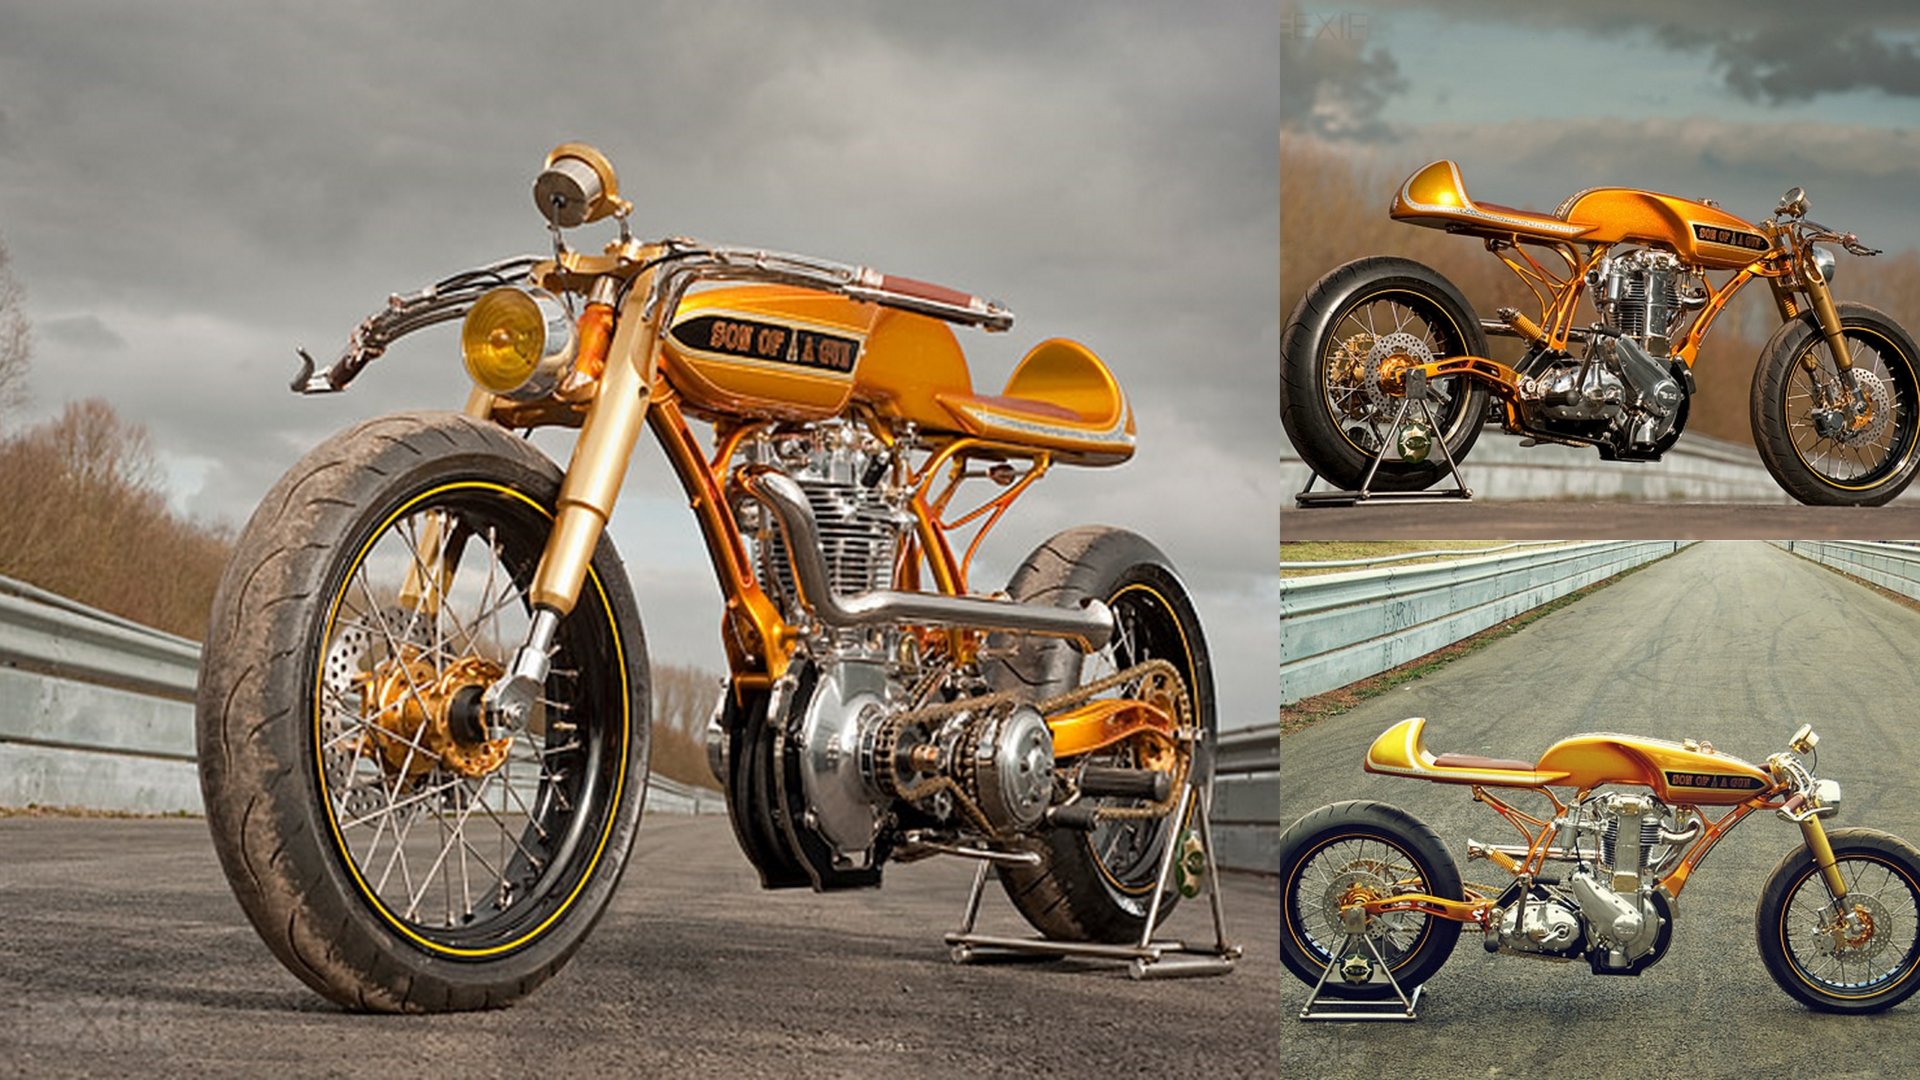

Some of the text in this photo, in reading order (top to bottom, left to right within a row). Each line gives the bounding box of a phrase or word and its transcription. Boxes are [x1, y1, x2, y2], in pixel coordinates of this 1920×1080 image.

[1699, 228, 1717, 240] SON
[710, 321, 753, 351] SON
[758, 328, 785, 356] OF
[819, 339, 851, 369] GUN
[1672, 774, 1694, 786] SON
[1696, 775, 1710, 787] OF
[1729, 777, 1751, 788] GUN
